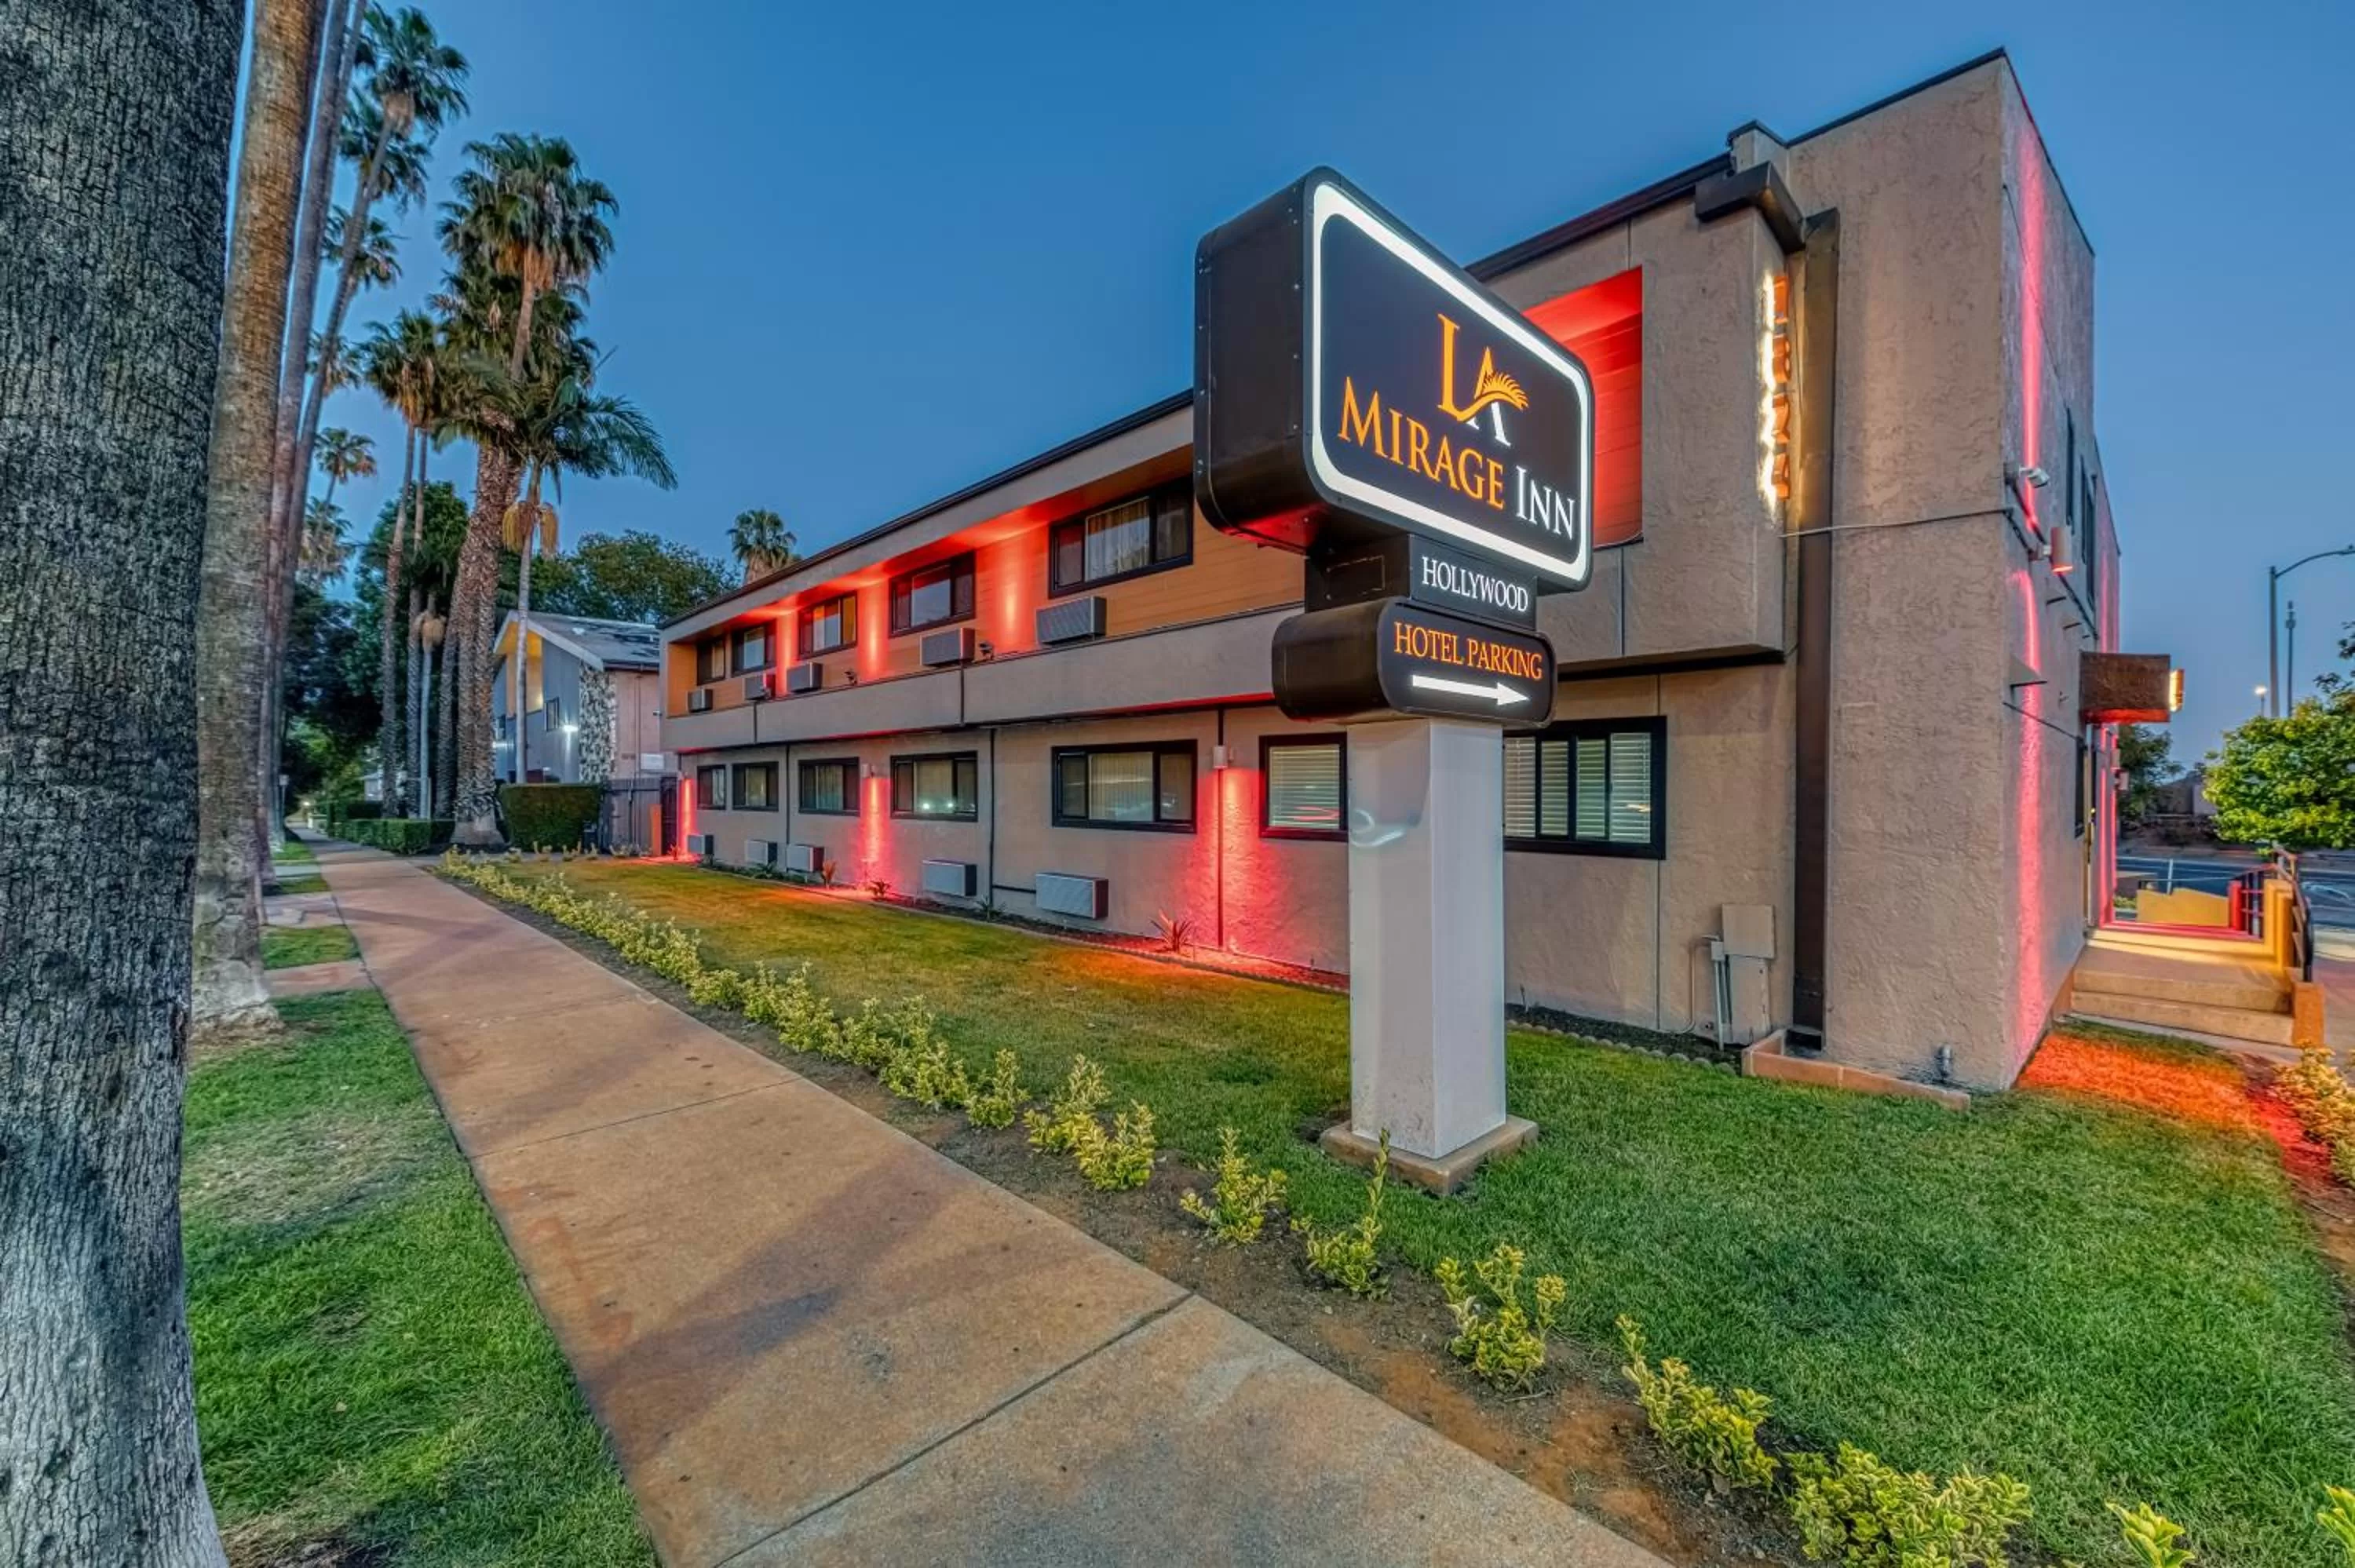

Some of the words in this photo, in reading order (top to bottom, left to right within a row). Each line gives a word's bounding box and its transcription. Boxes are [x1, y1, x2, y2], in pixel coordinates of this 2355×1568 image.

[1437, 313, 1529, 447] LA
[1337, 376, 1506, 510] MIRAGE
[1516, 465, 1575, 541] INN
[1422, 556, 1529, 613] HOLLYWOOD
[1393, 621, 1464, 665] HOTEL
[1466, 638, 1543, 681] PARKING
